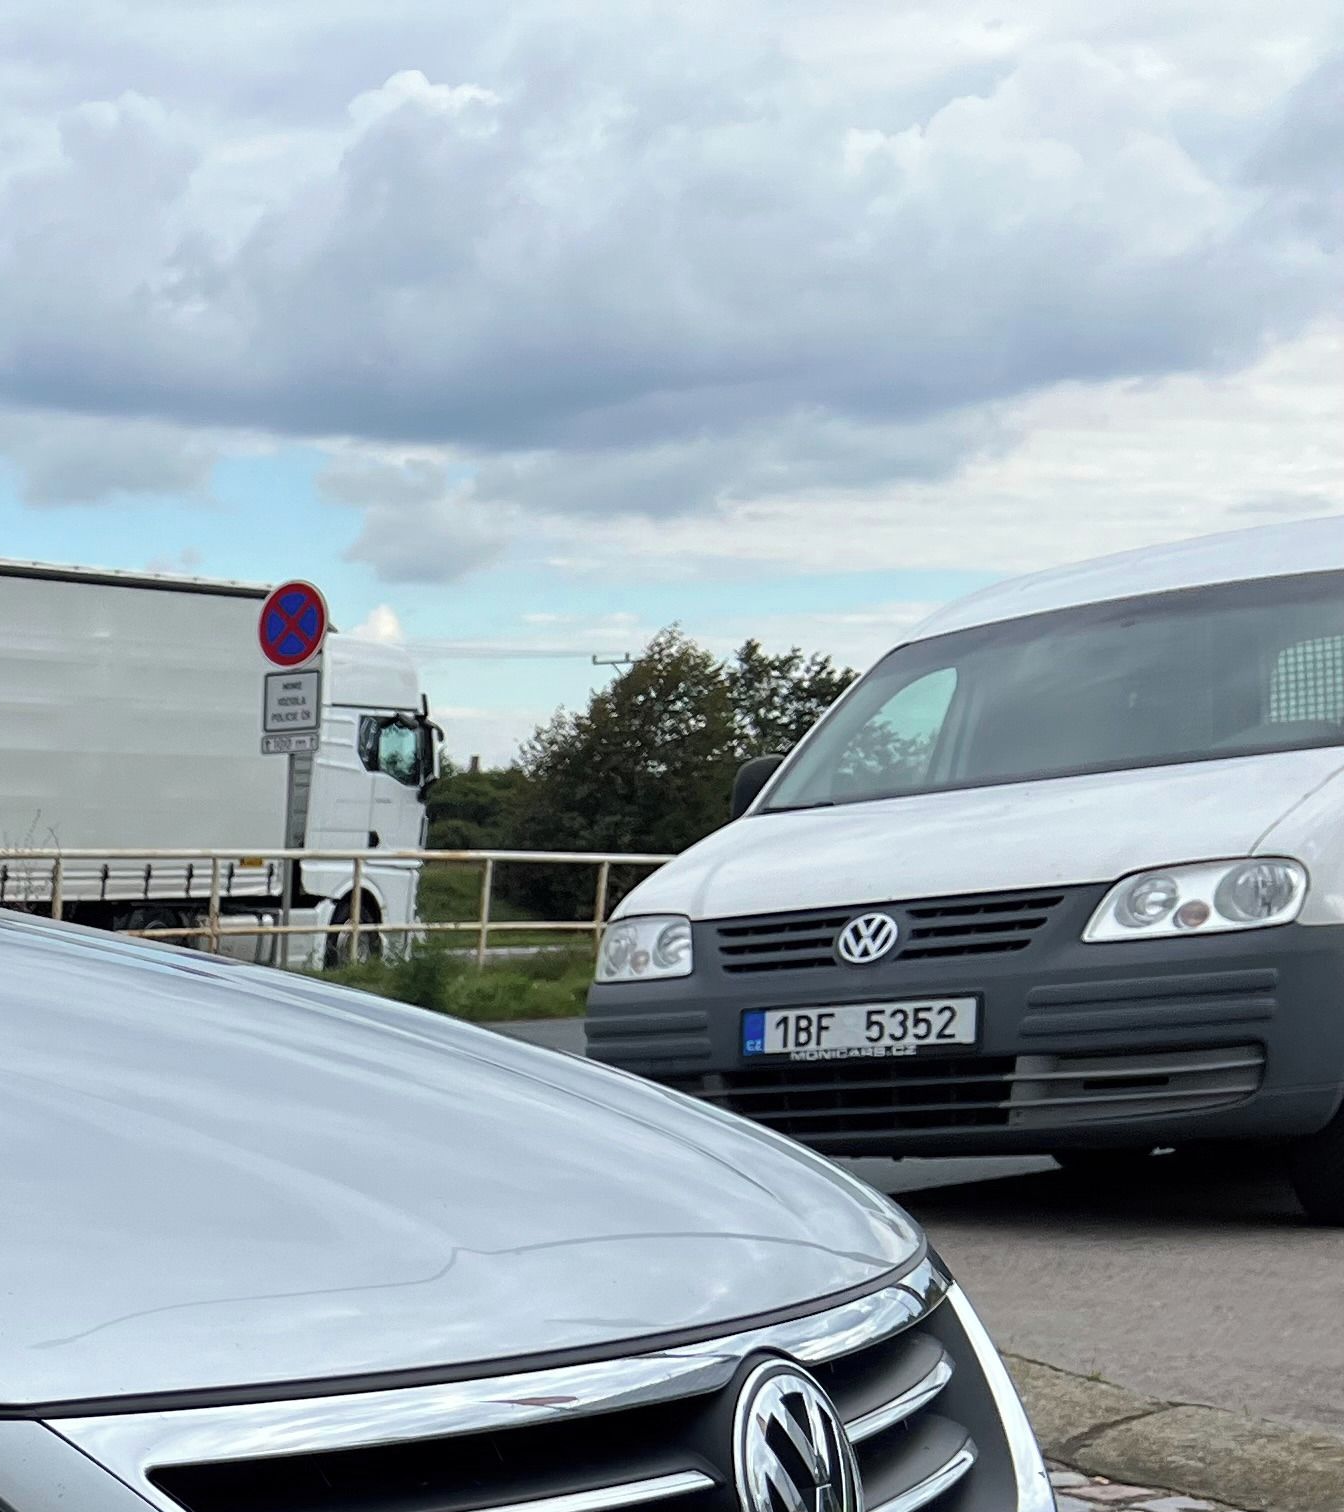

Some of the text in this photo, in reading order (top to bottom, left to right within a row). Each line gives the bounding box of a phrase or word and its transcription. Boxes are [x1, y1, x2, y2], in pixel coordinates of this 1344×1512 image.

[745, 1006, 957, 1051] CZ 1BF 5352
[790, 1044, 917, 1062] MONICARS.CZ
